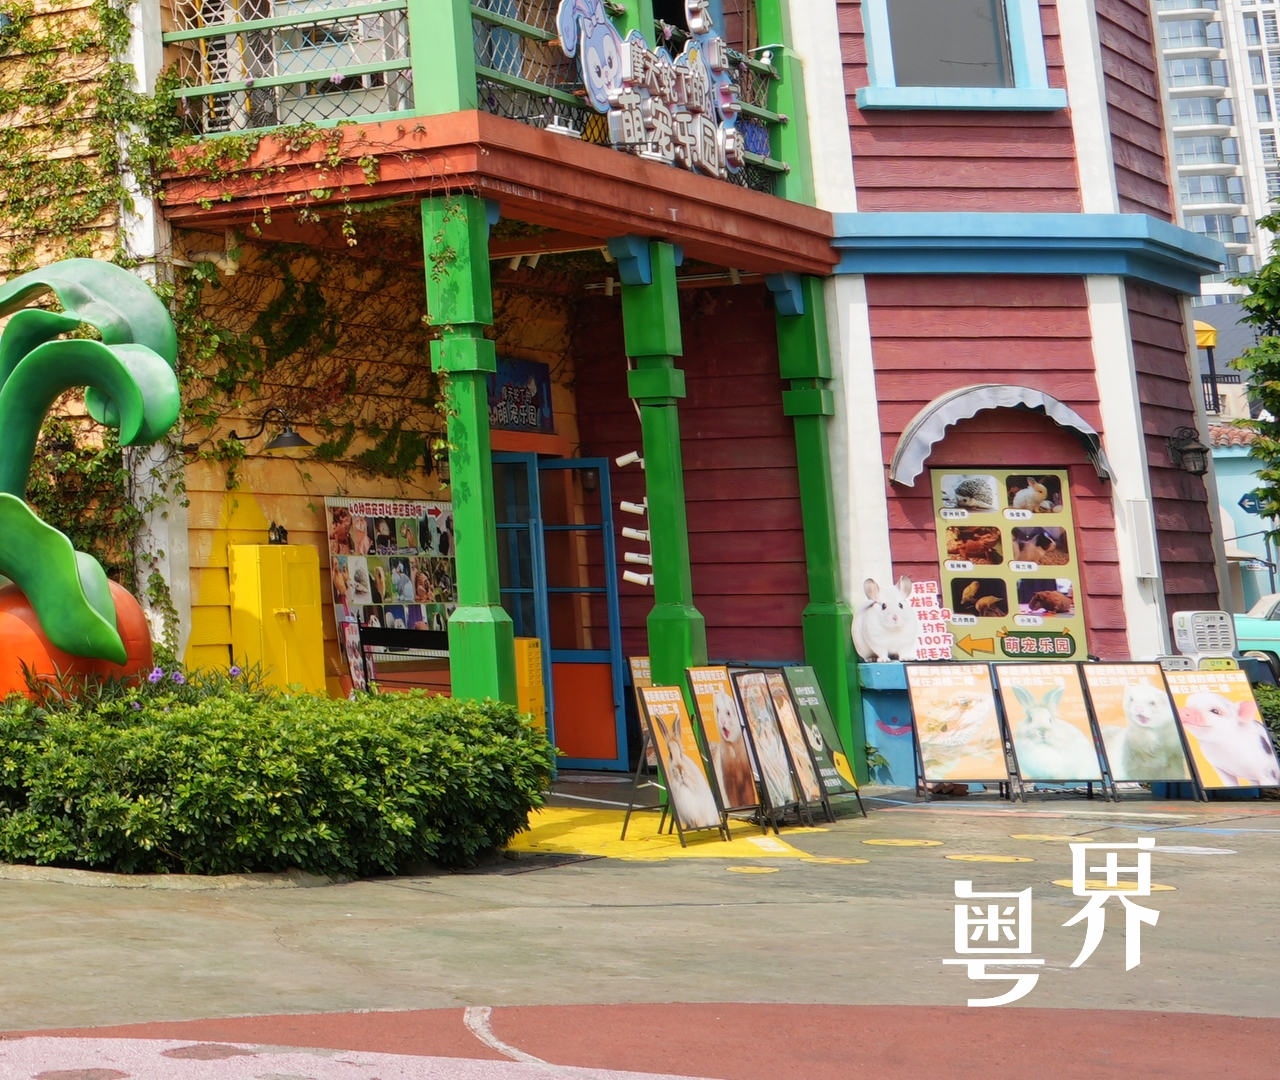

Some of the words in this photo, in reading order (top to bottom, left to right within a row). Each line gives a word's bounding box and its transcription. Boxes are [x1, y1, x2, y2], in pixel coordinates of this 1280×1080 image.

[612, 89, 722, 178] 萌宠乐园
[913, 582, 938, 594] 我是
[917, 609, 952, 620] 我全身
[922, 623, 946, 633] 约有
[917, 635, 952, 645] 100万
[1005, 637, 1070, 653] 萌宠乐园
